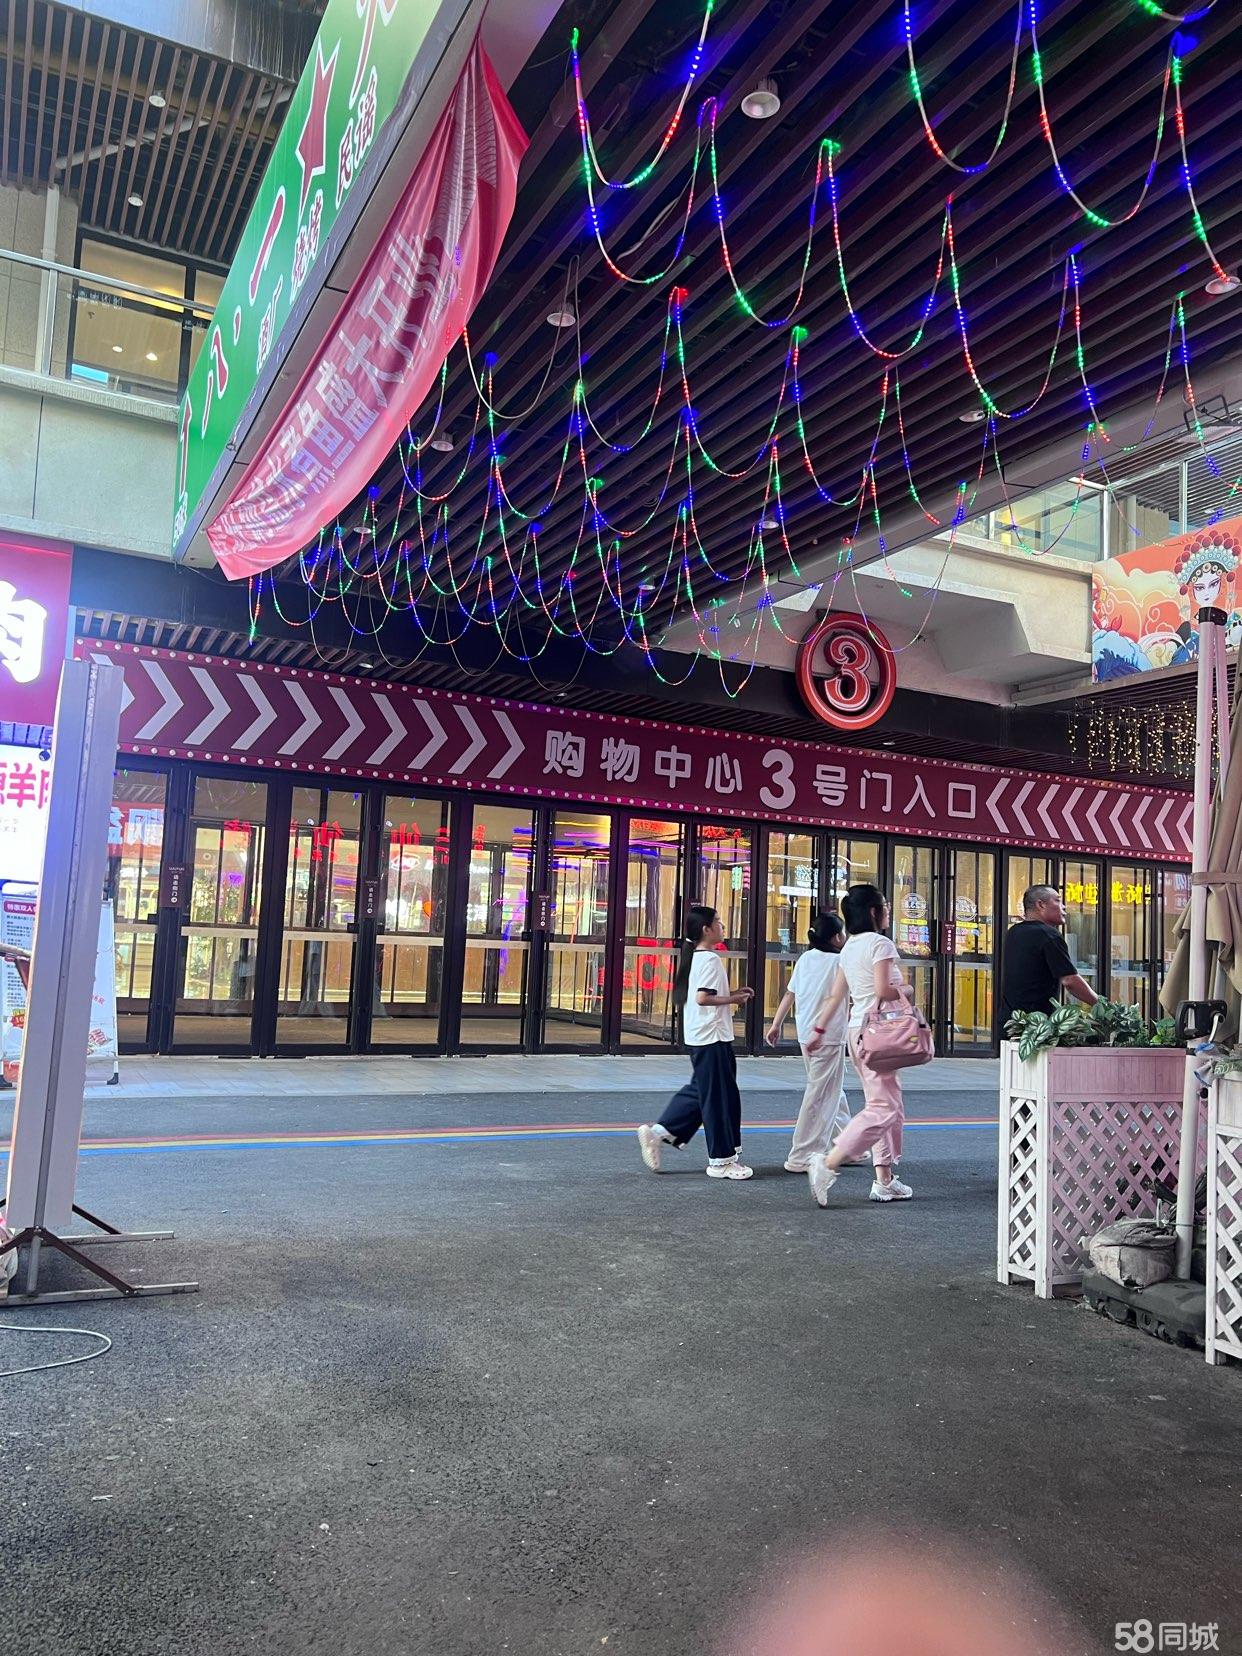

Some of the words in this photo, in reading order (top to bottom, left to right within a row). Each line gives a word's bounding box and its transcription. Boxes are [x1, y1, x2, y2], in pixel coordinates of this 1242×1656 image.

[336, 65, 377, 211] 民谣
[824, 634, 872, 712] 3
[542, 729, 977, 819] 购物中心3号门入口
